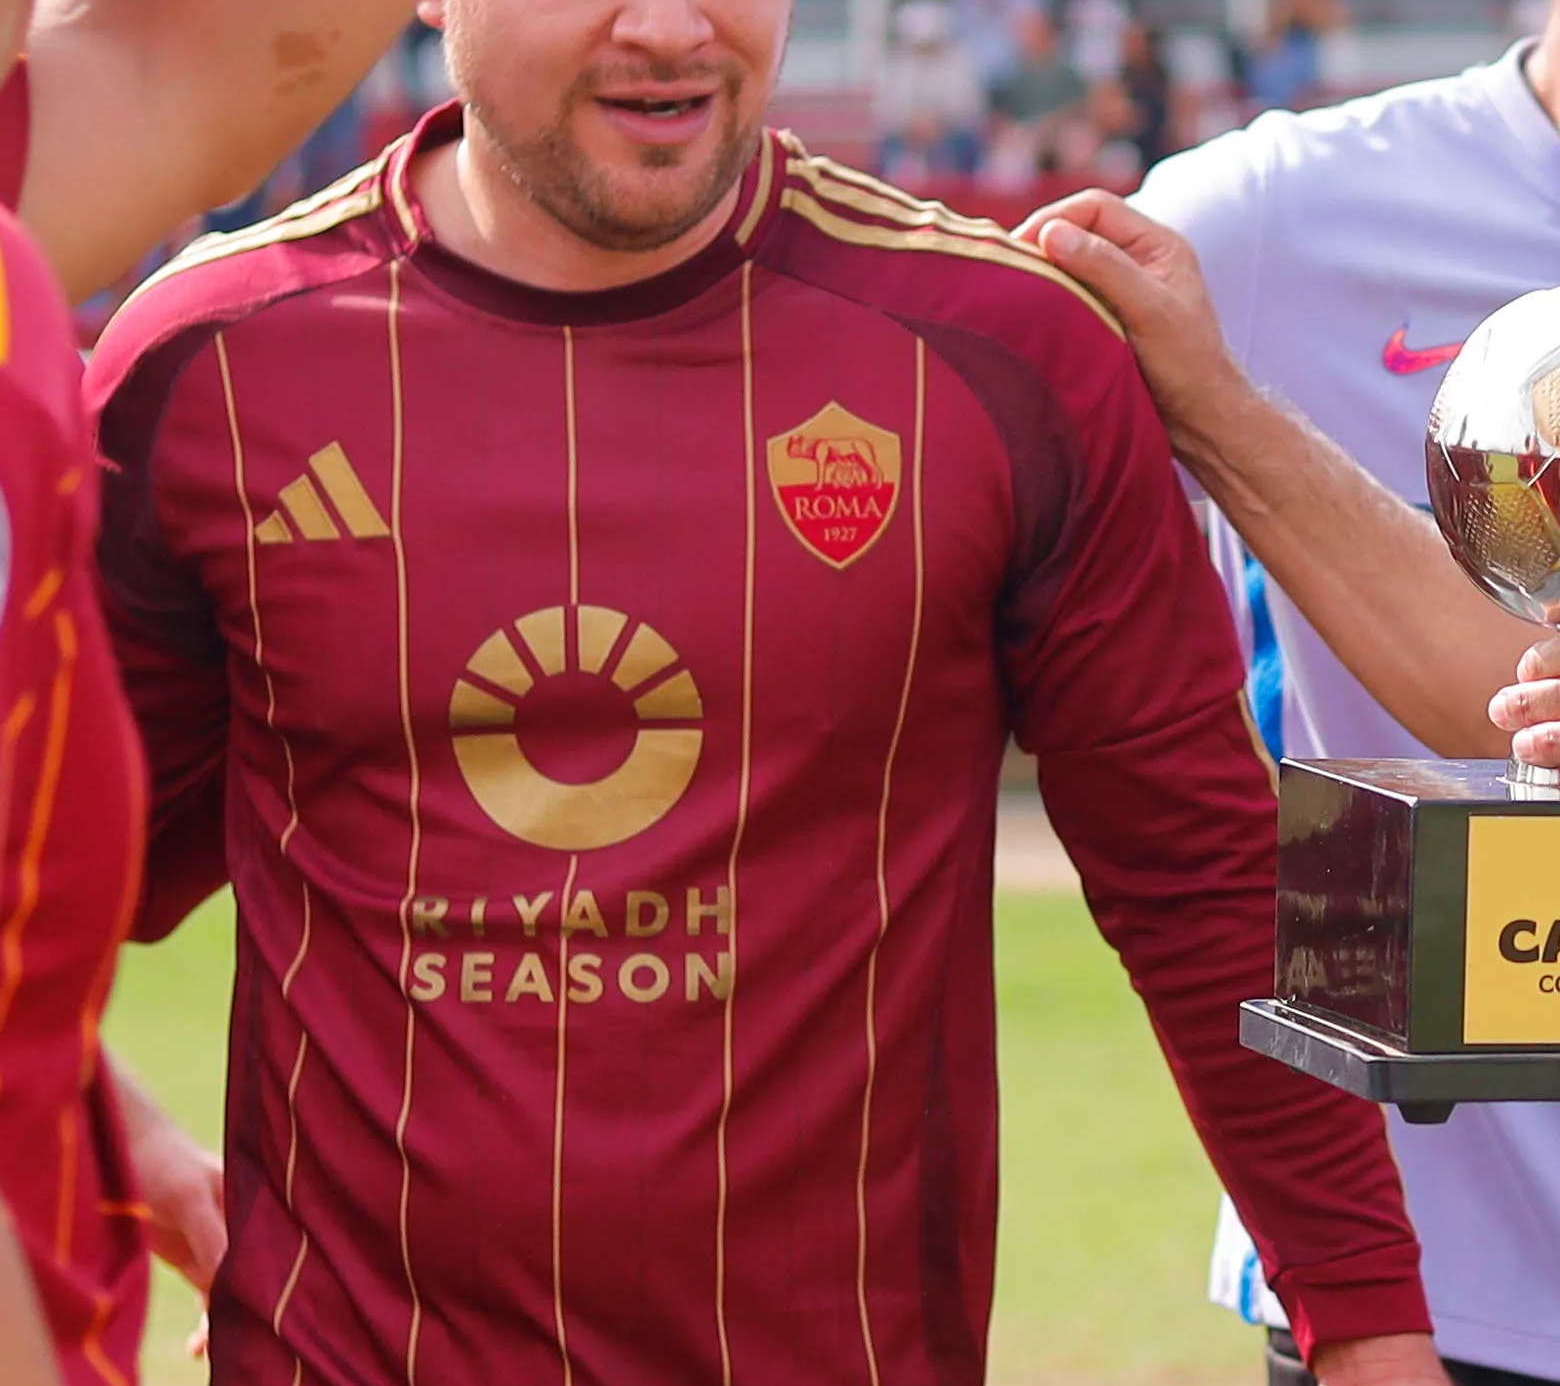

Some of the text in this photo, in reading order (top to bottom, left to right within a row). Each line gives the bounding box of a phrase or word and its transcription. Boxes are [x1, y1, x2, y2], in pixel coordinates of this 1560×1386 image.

[794, 494, 882, 521] ROMA
[823, 526, 858, 543] 1927
[411, 885, 731, 939] RIYADH
[409, 951, 733, 1004] SEASON
